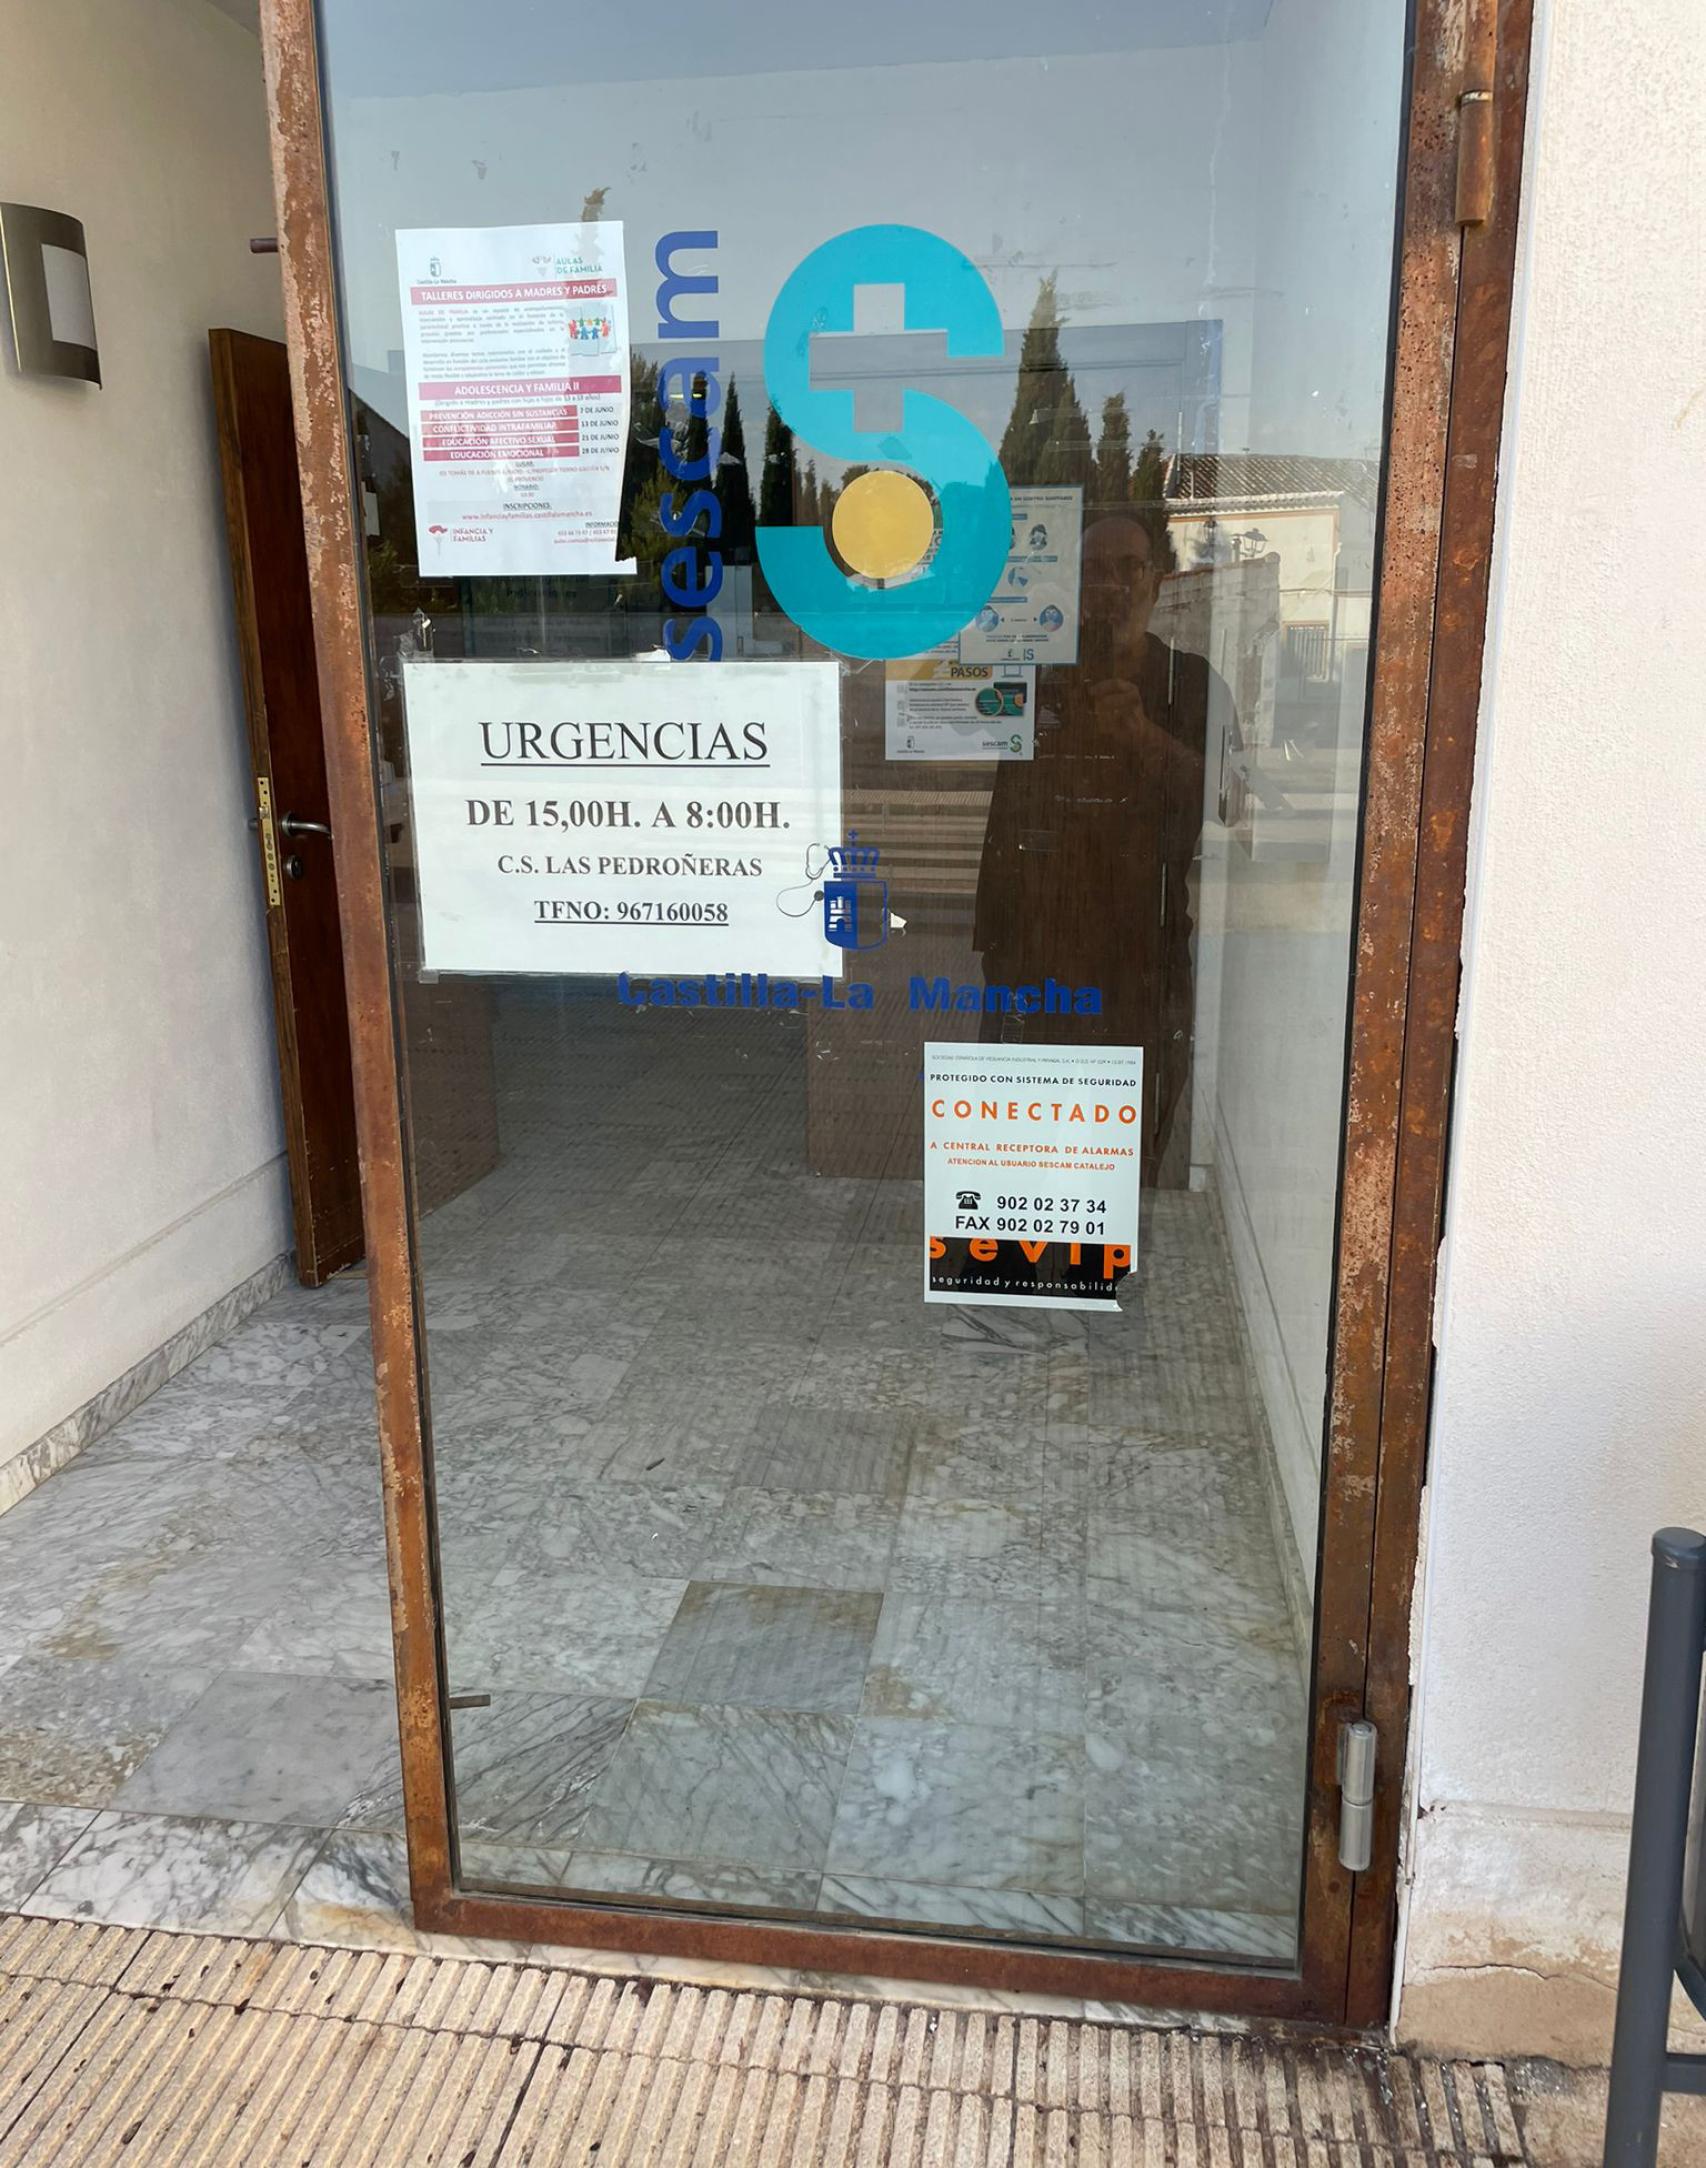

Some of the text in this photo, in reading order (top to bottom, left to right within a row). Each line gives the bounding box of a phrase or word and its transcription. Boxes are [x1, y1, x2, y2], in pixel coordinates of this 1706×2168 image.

[556, 256, 583, 266] AULAS
[556, 264, 603, 275] DE FAMILIA
[421, 290, 463, 301] TALLERES
[465, 288, 513, 300] DIRIGIDOS
[515, 287, 523, 298] A
[523, 285, 563, 298] MADRES
[564, 285, 571, 295] Y
[454, 381, 580, 396] ADOLESCENCIA Y FAMILIA II
[429, 410, 475, 421] PREVENCIÓN
[476, 408, 510, 420] ADICCIÓN
[511, 408, 524, 418] SIN
[525, 406, 568, 418] SUSTANCIAS
[599, 419, 619, 427] JUNIO
[600, 433, 620, 441] JUNIO
[450, 448, 497, 460] EDUCACIÓN
[600, 446, 620, 454] JUNIO
[655, 229, 724, 662] sescam
[950, 666, 989, 678] PASOS
[478, 720, 769, 762] URGENCIAS
[982, 740, 1009, 748] sescam
[466, 799, 791, 833] DE 15,00H. A 8:00H.
[497, 852, 763, 878] C.S. LAS PEDROÑERAS
[534, 900, 729, 923] TFNO: 967160058
[909, 975, 1104, 1016] Mancha
[930, 1073, 1137, 1088] PROTEGIDO CON SISTEMA DE SEGURIDAD
[931, 1099, 1137, 1125] CONECTADO
[930, 1142, 1134, 1156] A CENTRAL RECEPTORA DE ALARMAS
[947, 1157, 1115, 1171] ATENCION AL USUARIO SESCAM CATALEJO
[996, 1195, 1107, 1214] 902 02 37 34
[955, 1215, 1105, 1236] FAX 902 02 79 01
[932, 1275, 1119, 1292] seguridad y responsabilid
